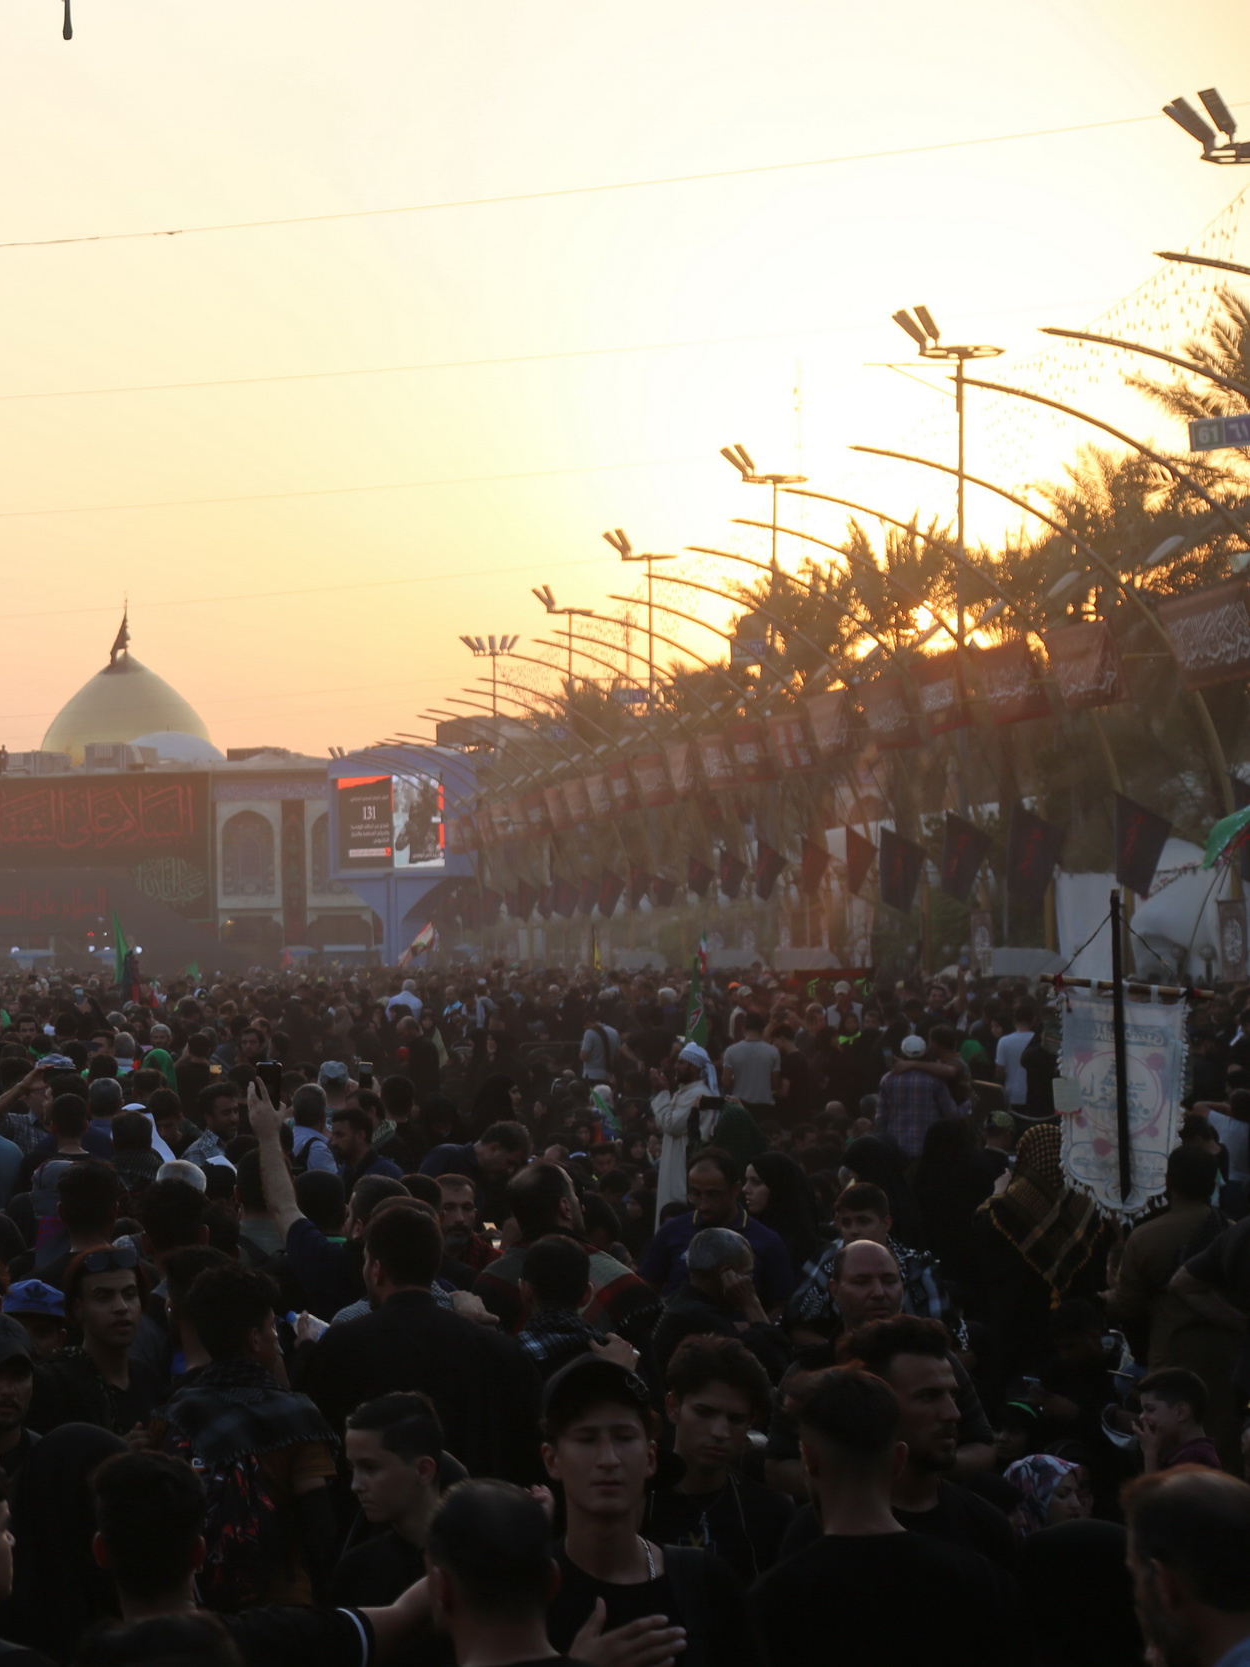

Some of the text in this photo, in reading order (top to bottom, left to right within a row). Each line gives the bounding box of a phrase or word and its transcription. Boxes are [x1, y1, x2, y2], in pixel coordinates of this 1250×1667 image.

[1198, 425, 1219, 443] 61
[362, 805, 377, 820] 131
[30, 888, 58, 921] على
[61, 887, 107, 920] السلام
